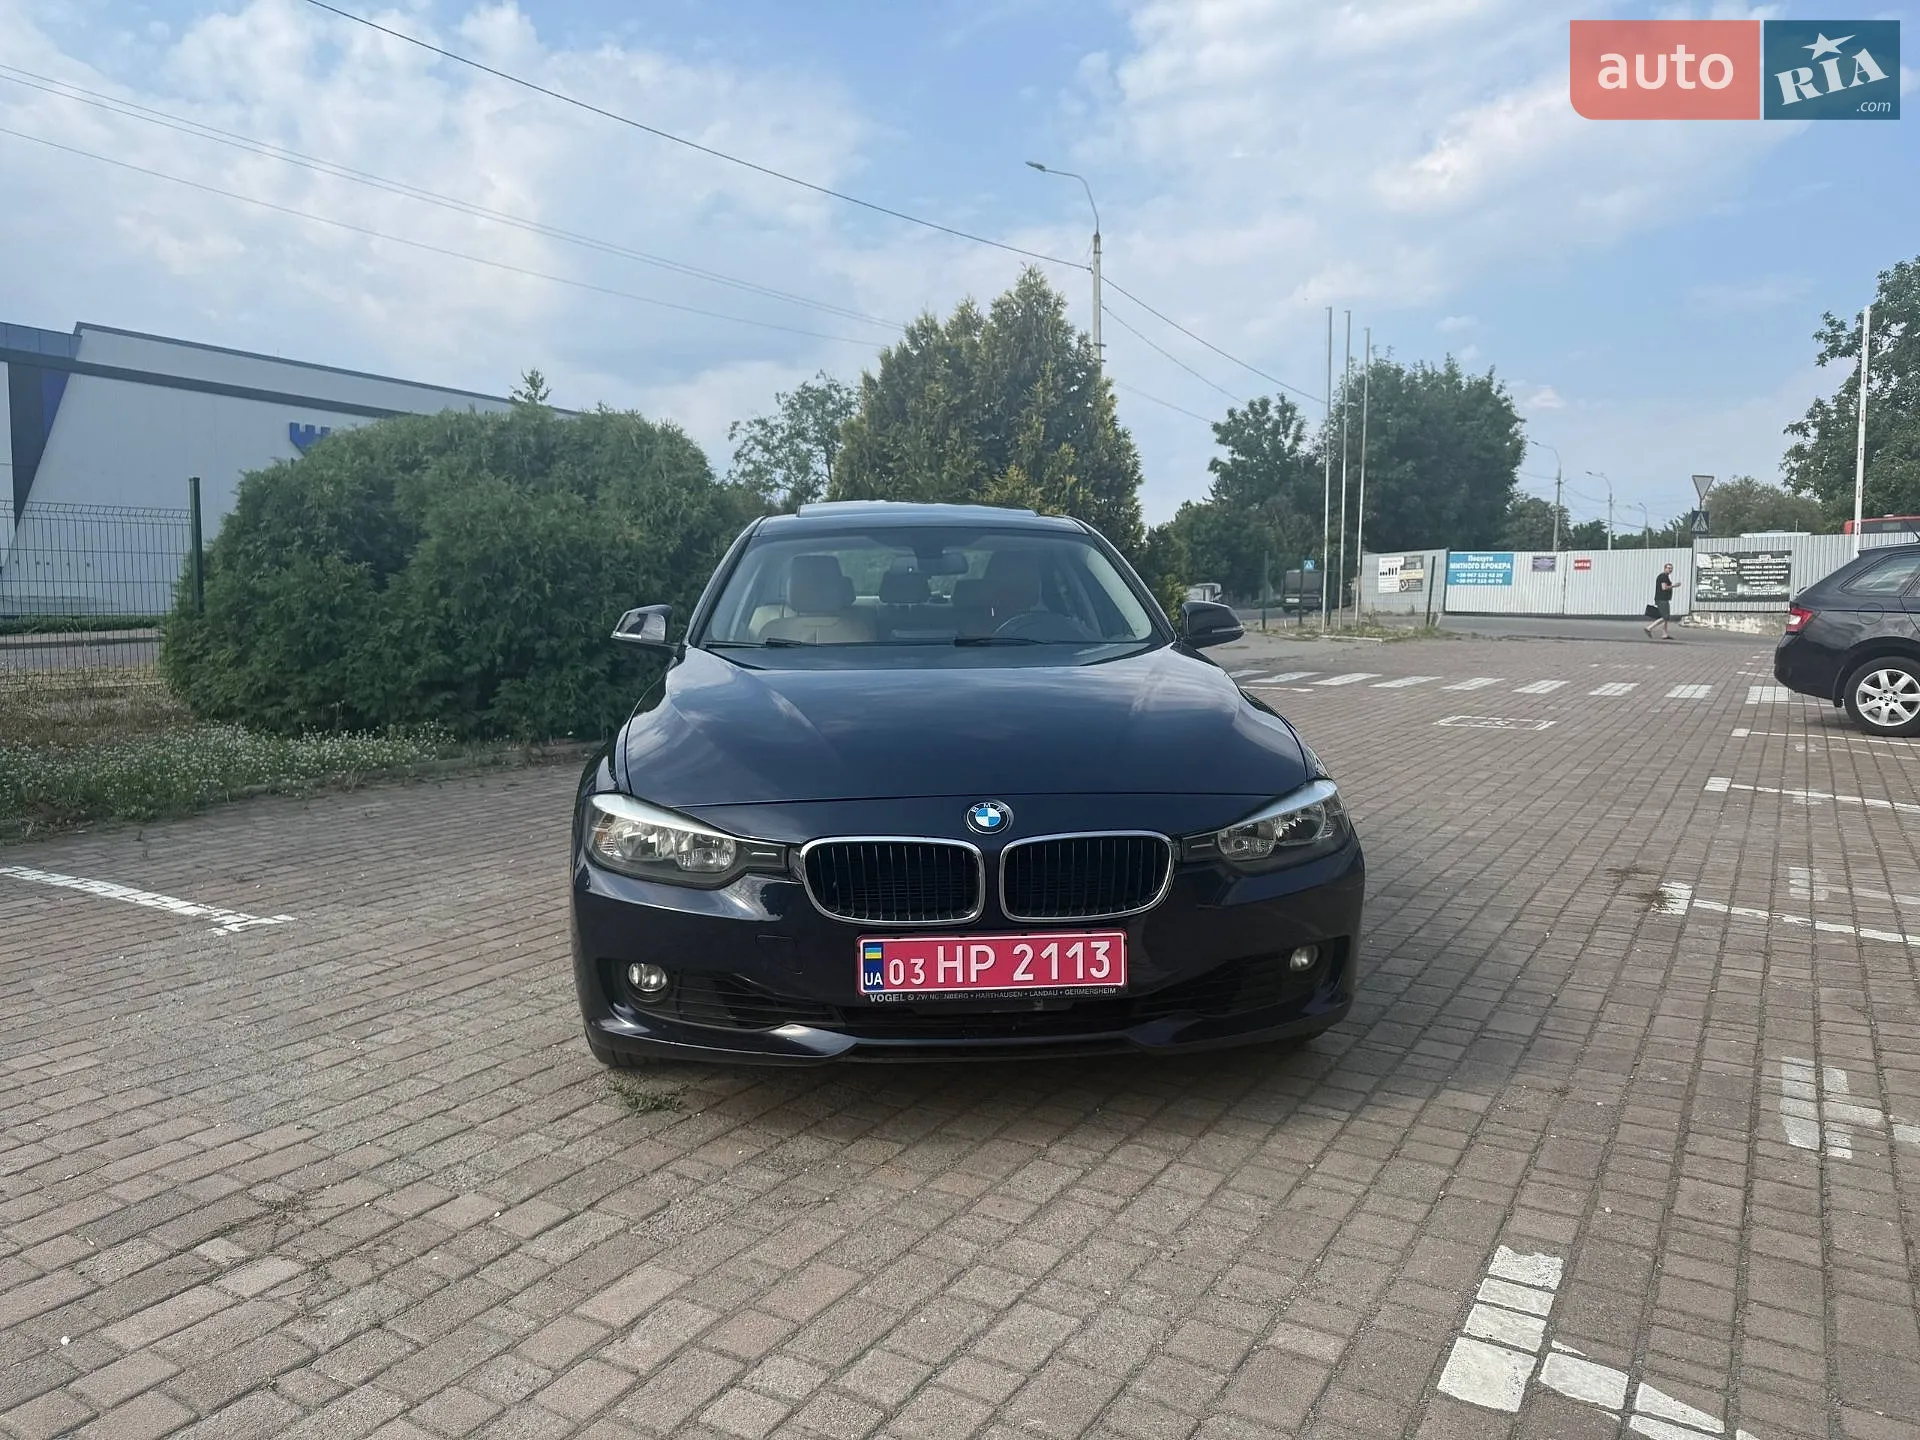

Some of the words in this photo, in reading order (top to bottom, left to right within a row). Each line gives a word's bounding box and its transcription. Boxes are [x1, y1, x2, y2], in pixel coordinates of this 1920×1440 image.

[936, 944, 997, 984] HP
[1012, 941, 1111, 982] 2113
[865, 972, 884, 986] UA
[869, 992, 906, 1003] VOGEL
[1029, 989, 1058, 997] LANDAU
[1064, 987, 1116, 996] GERMERSHEIM
